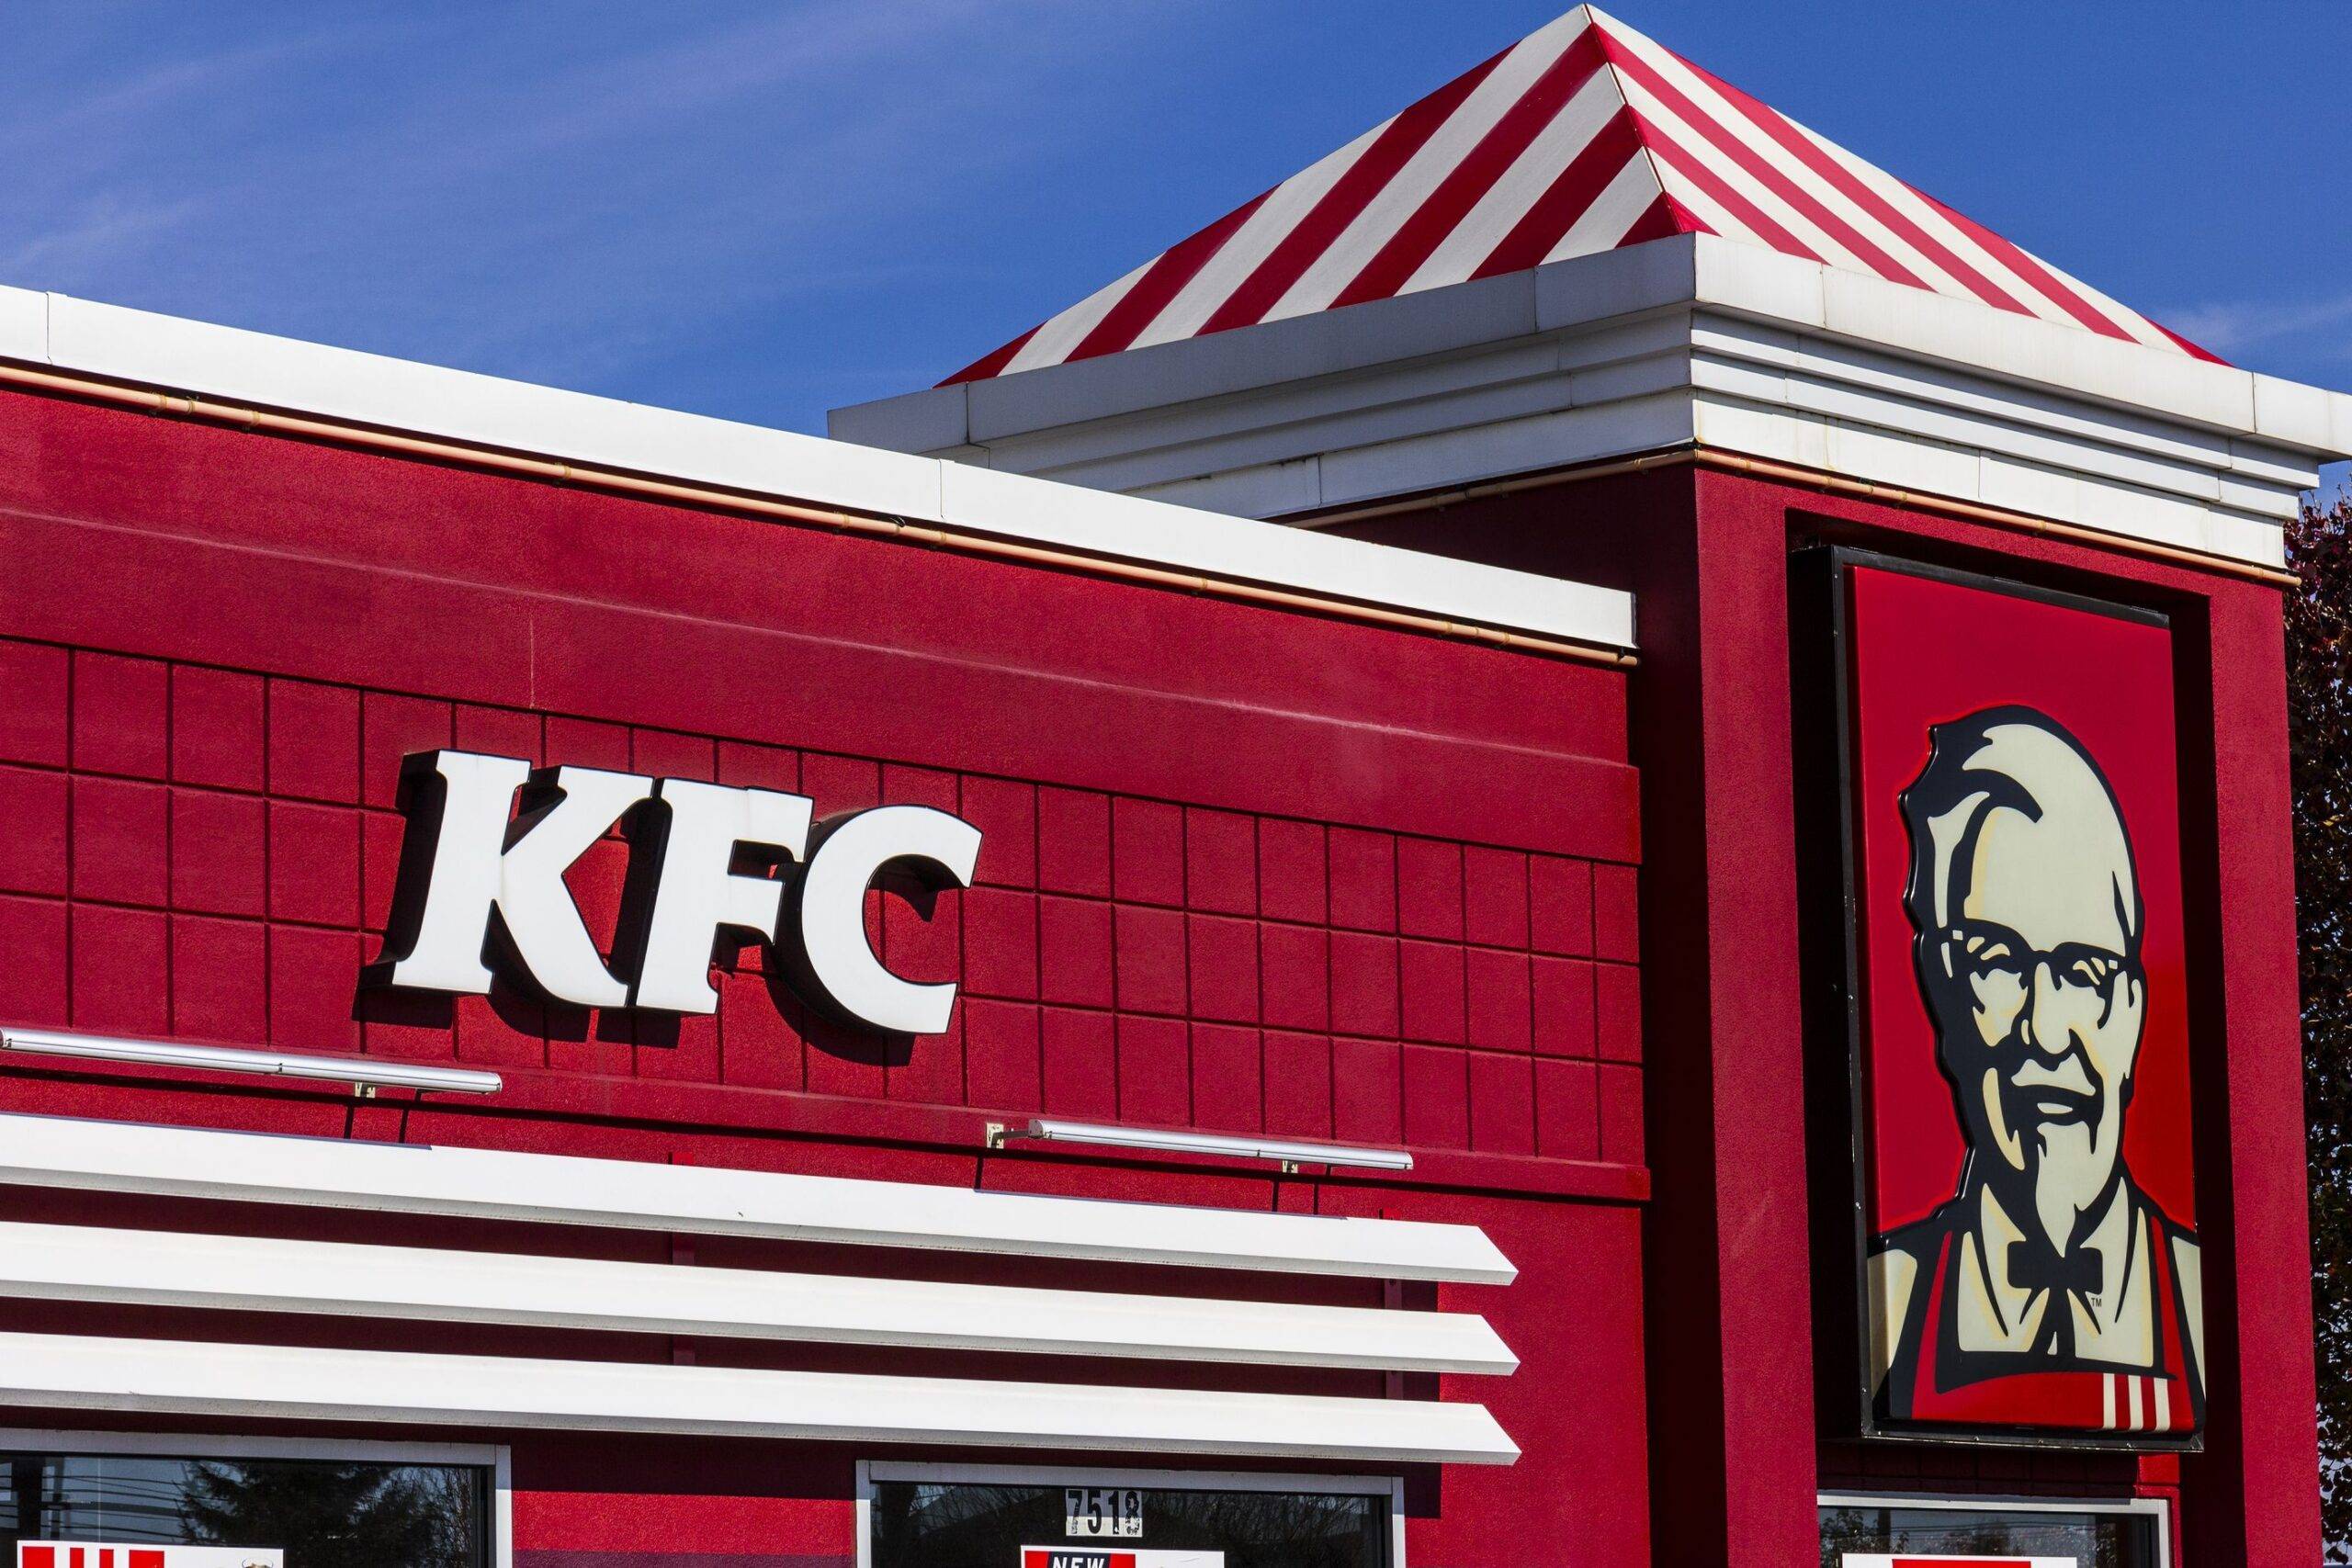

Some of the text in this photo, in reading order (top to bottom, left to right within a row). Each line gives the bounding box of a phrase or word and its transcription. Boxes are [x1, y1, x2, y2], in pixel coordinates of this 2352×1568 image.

[392, 750, 984, 1035] KFC
[2091, 1297, 2102, 1307] TM
[1068, 1489, 1140, 1535] 7518
